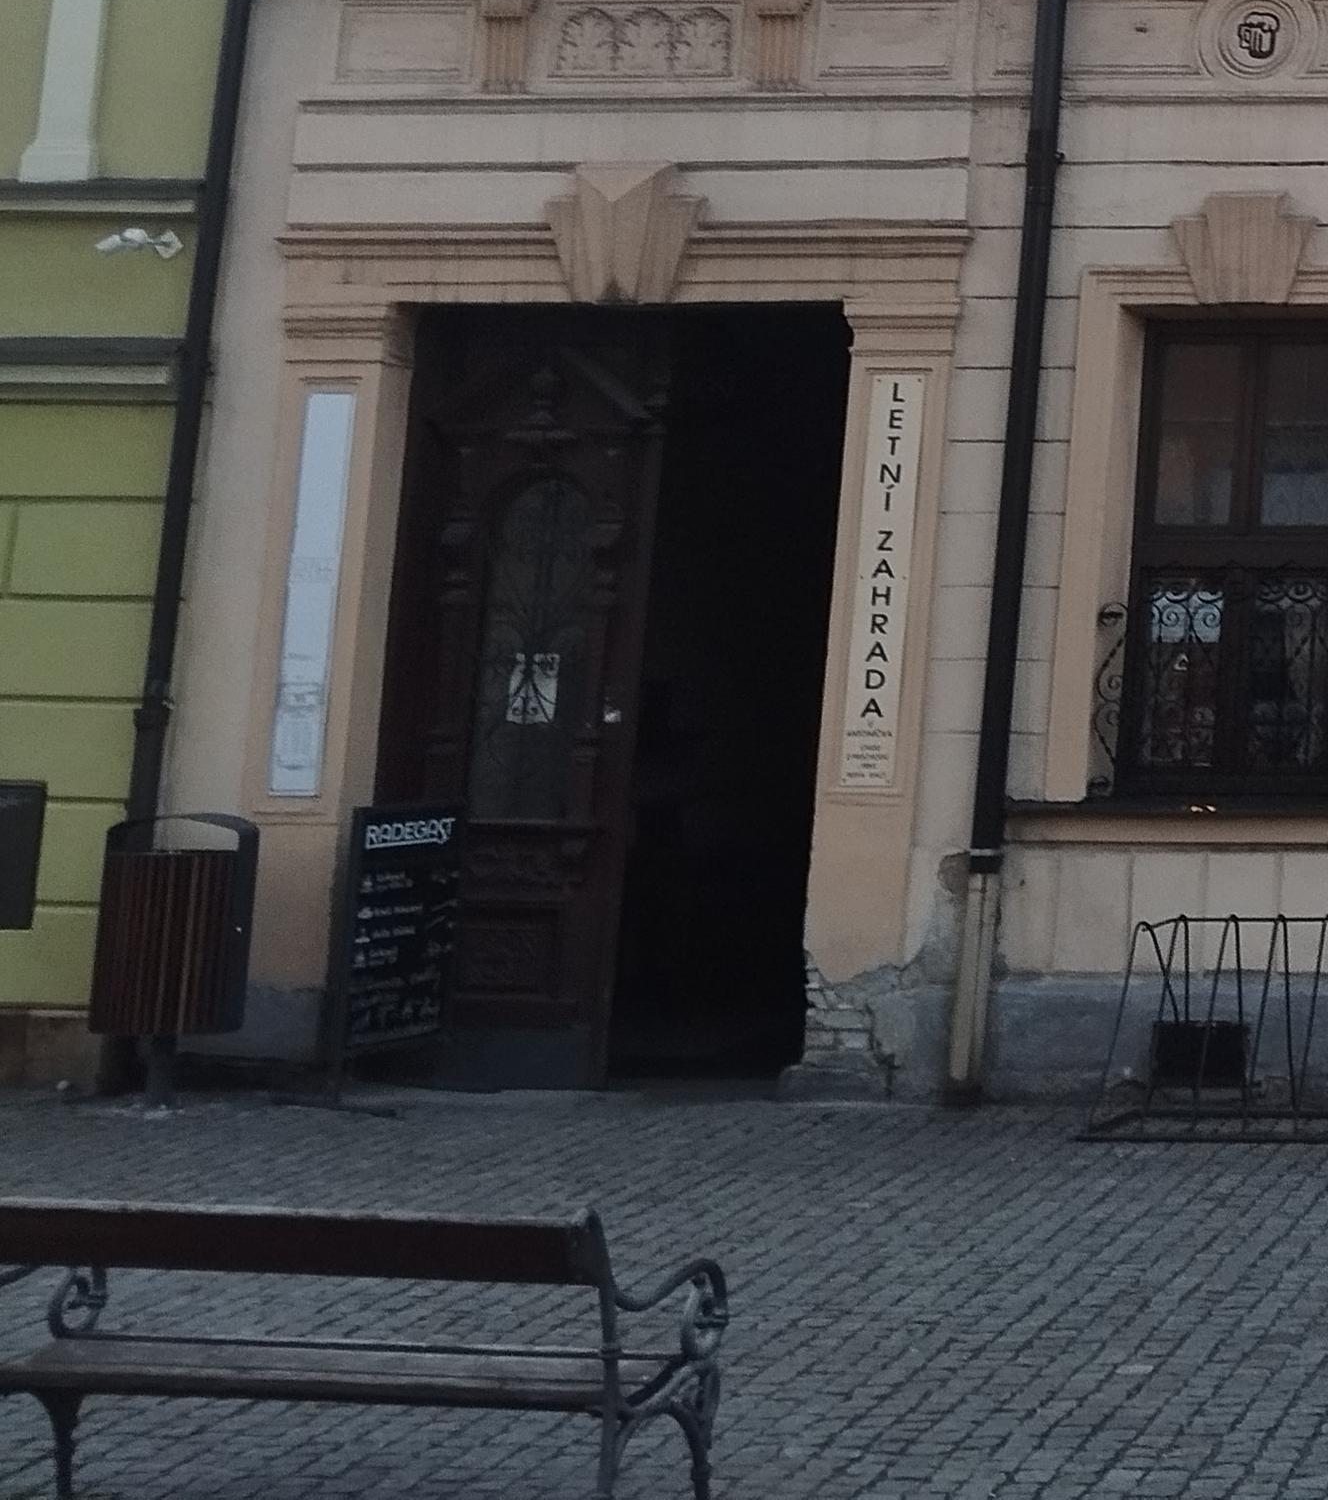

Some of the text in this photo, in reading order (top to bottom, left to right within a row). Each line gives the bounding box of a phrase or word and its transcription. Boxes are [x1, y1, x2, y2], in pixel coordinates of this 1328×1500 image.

[879, 381, 906, 512] LETNÍ
[860, 530, 896, 718] ZAHRADA
[365, 817, 456, 849] RADEGAST
